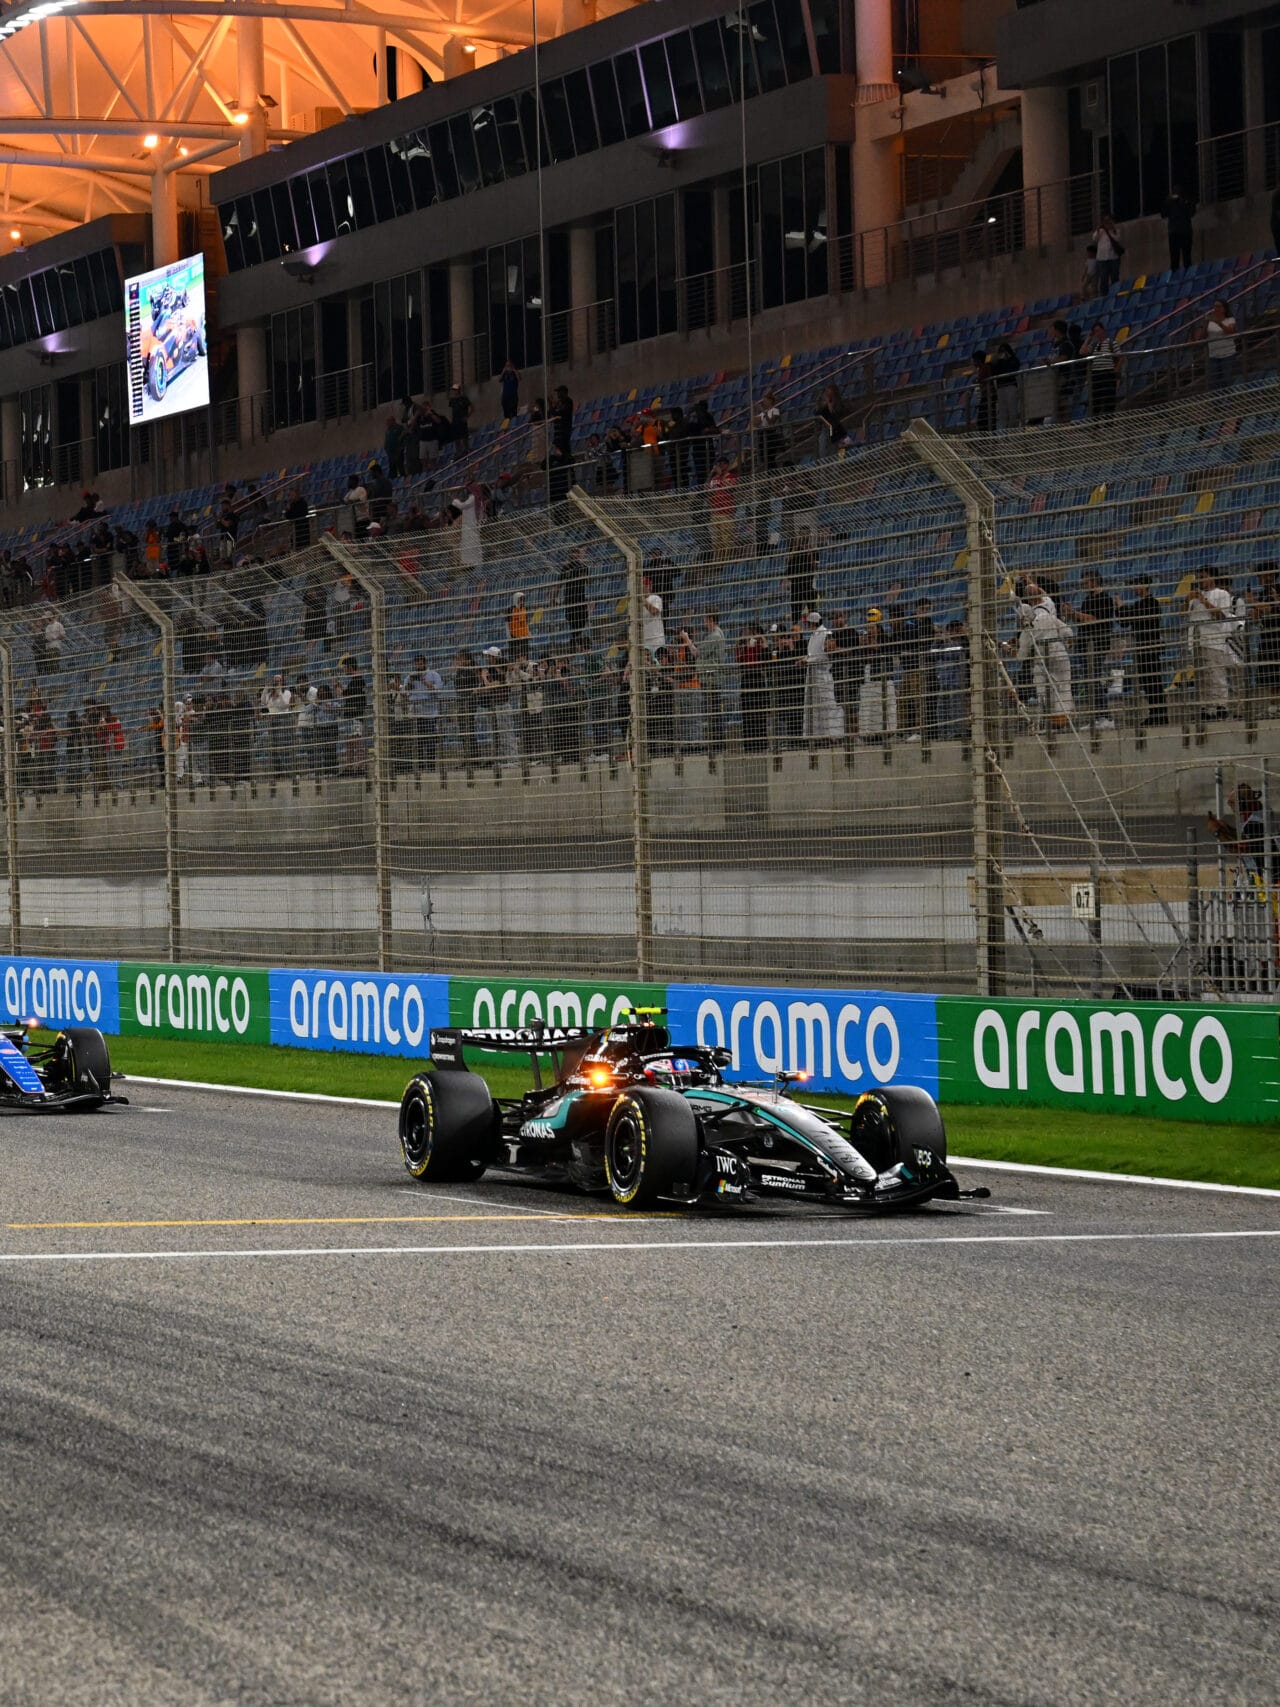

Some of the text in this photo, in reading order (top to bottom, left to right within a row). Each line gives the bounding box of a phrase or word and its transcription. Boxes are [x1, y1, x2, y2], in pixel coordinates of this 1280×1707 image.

[1076, 891, 1090, 908] 0.7
[4, 966, 101, 1022] aramco
[135, 972, 250, 1034] aramco
[289, 978, 424, 1047] aramco
[696, 998, 900, 1082] aramco
[973, 1008, 1233, 1103] aramco
[716, 1155, 738, 1175] IWC
